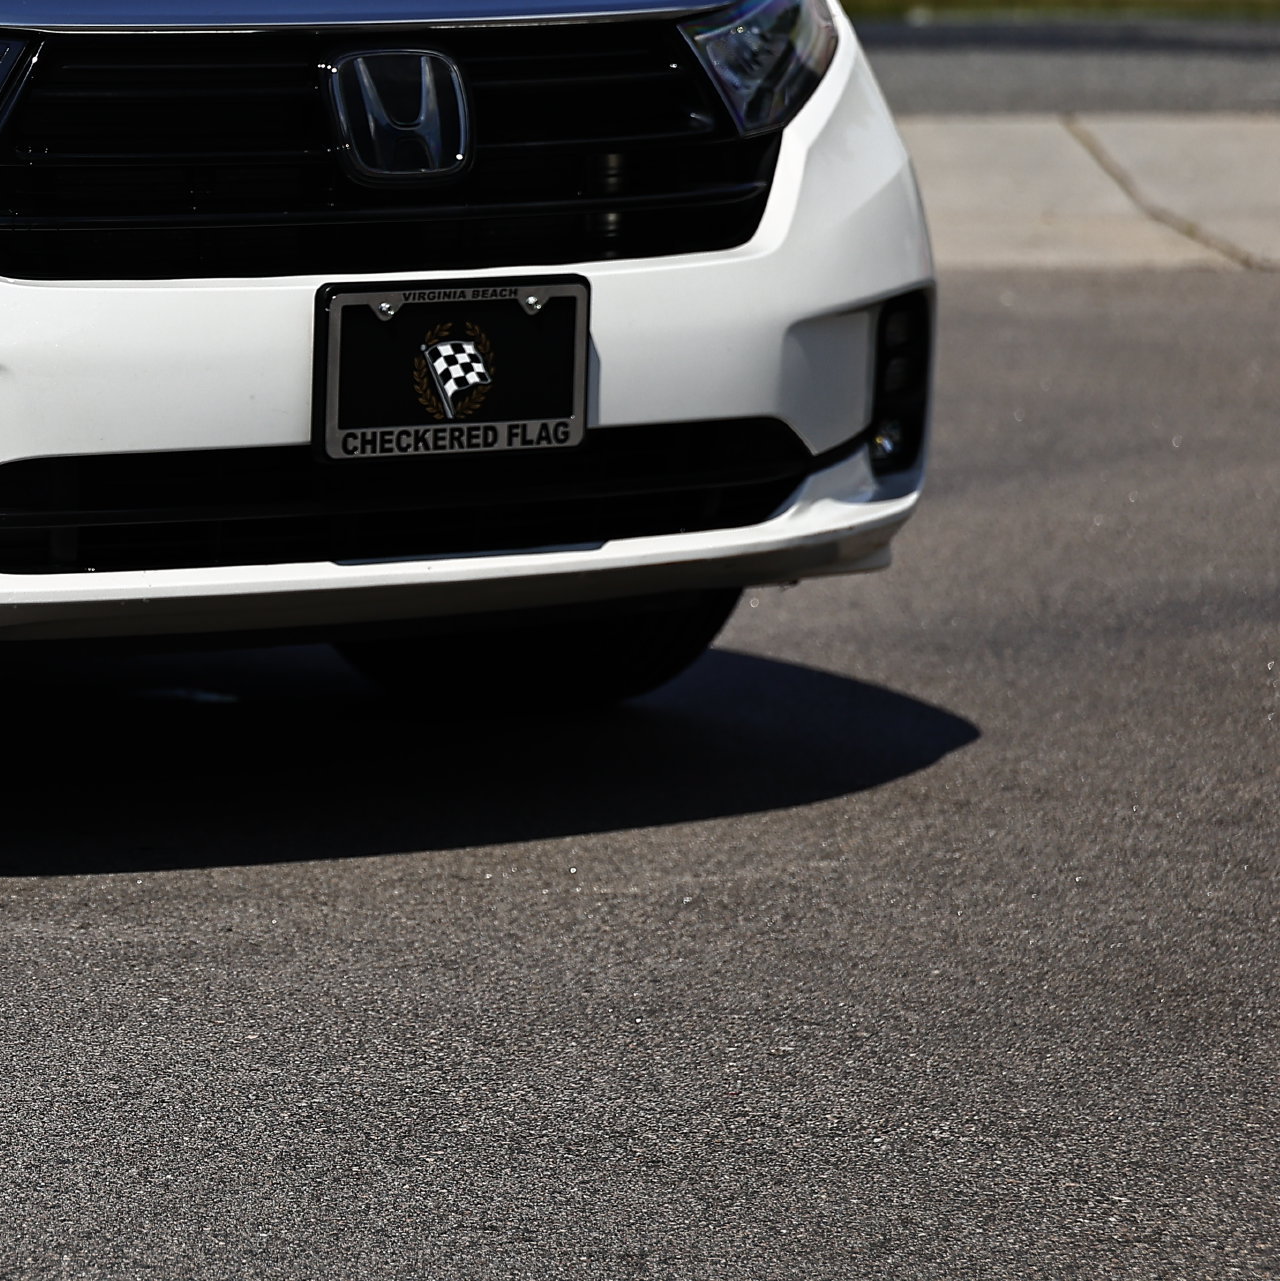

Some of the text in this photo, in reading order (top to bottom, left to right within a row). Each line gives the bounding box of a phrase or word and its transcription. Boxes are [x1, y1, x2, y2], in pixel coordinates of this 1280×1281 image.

[402, 288, 519, 301] VIRGINIA BEACH
[341, 422, 570, 455] CHECKERED FLAG
